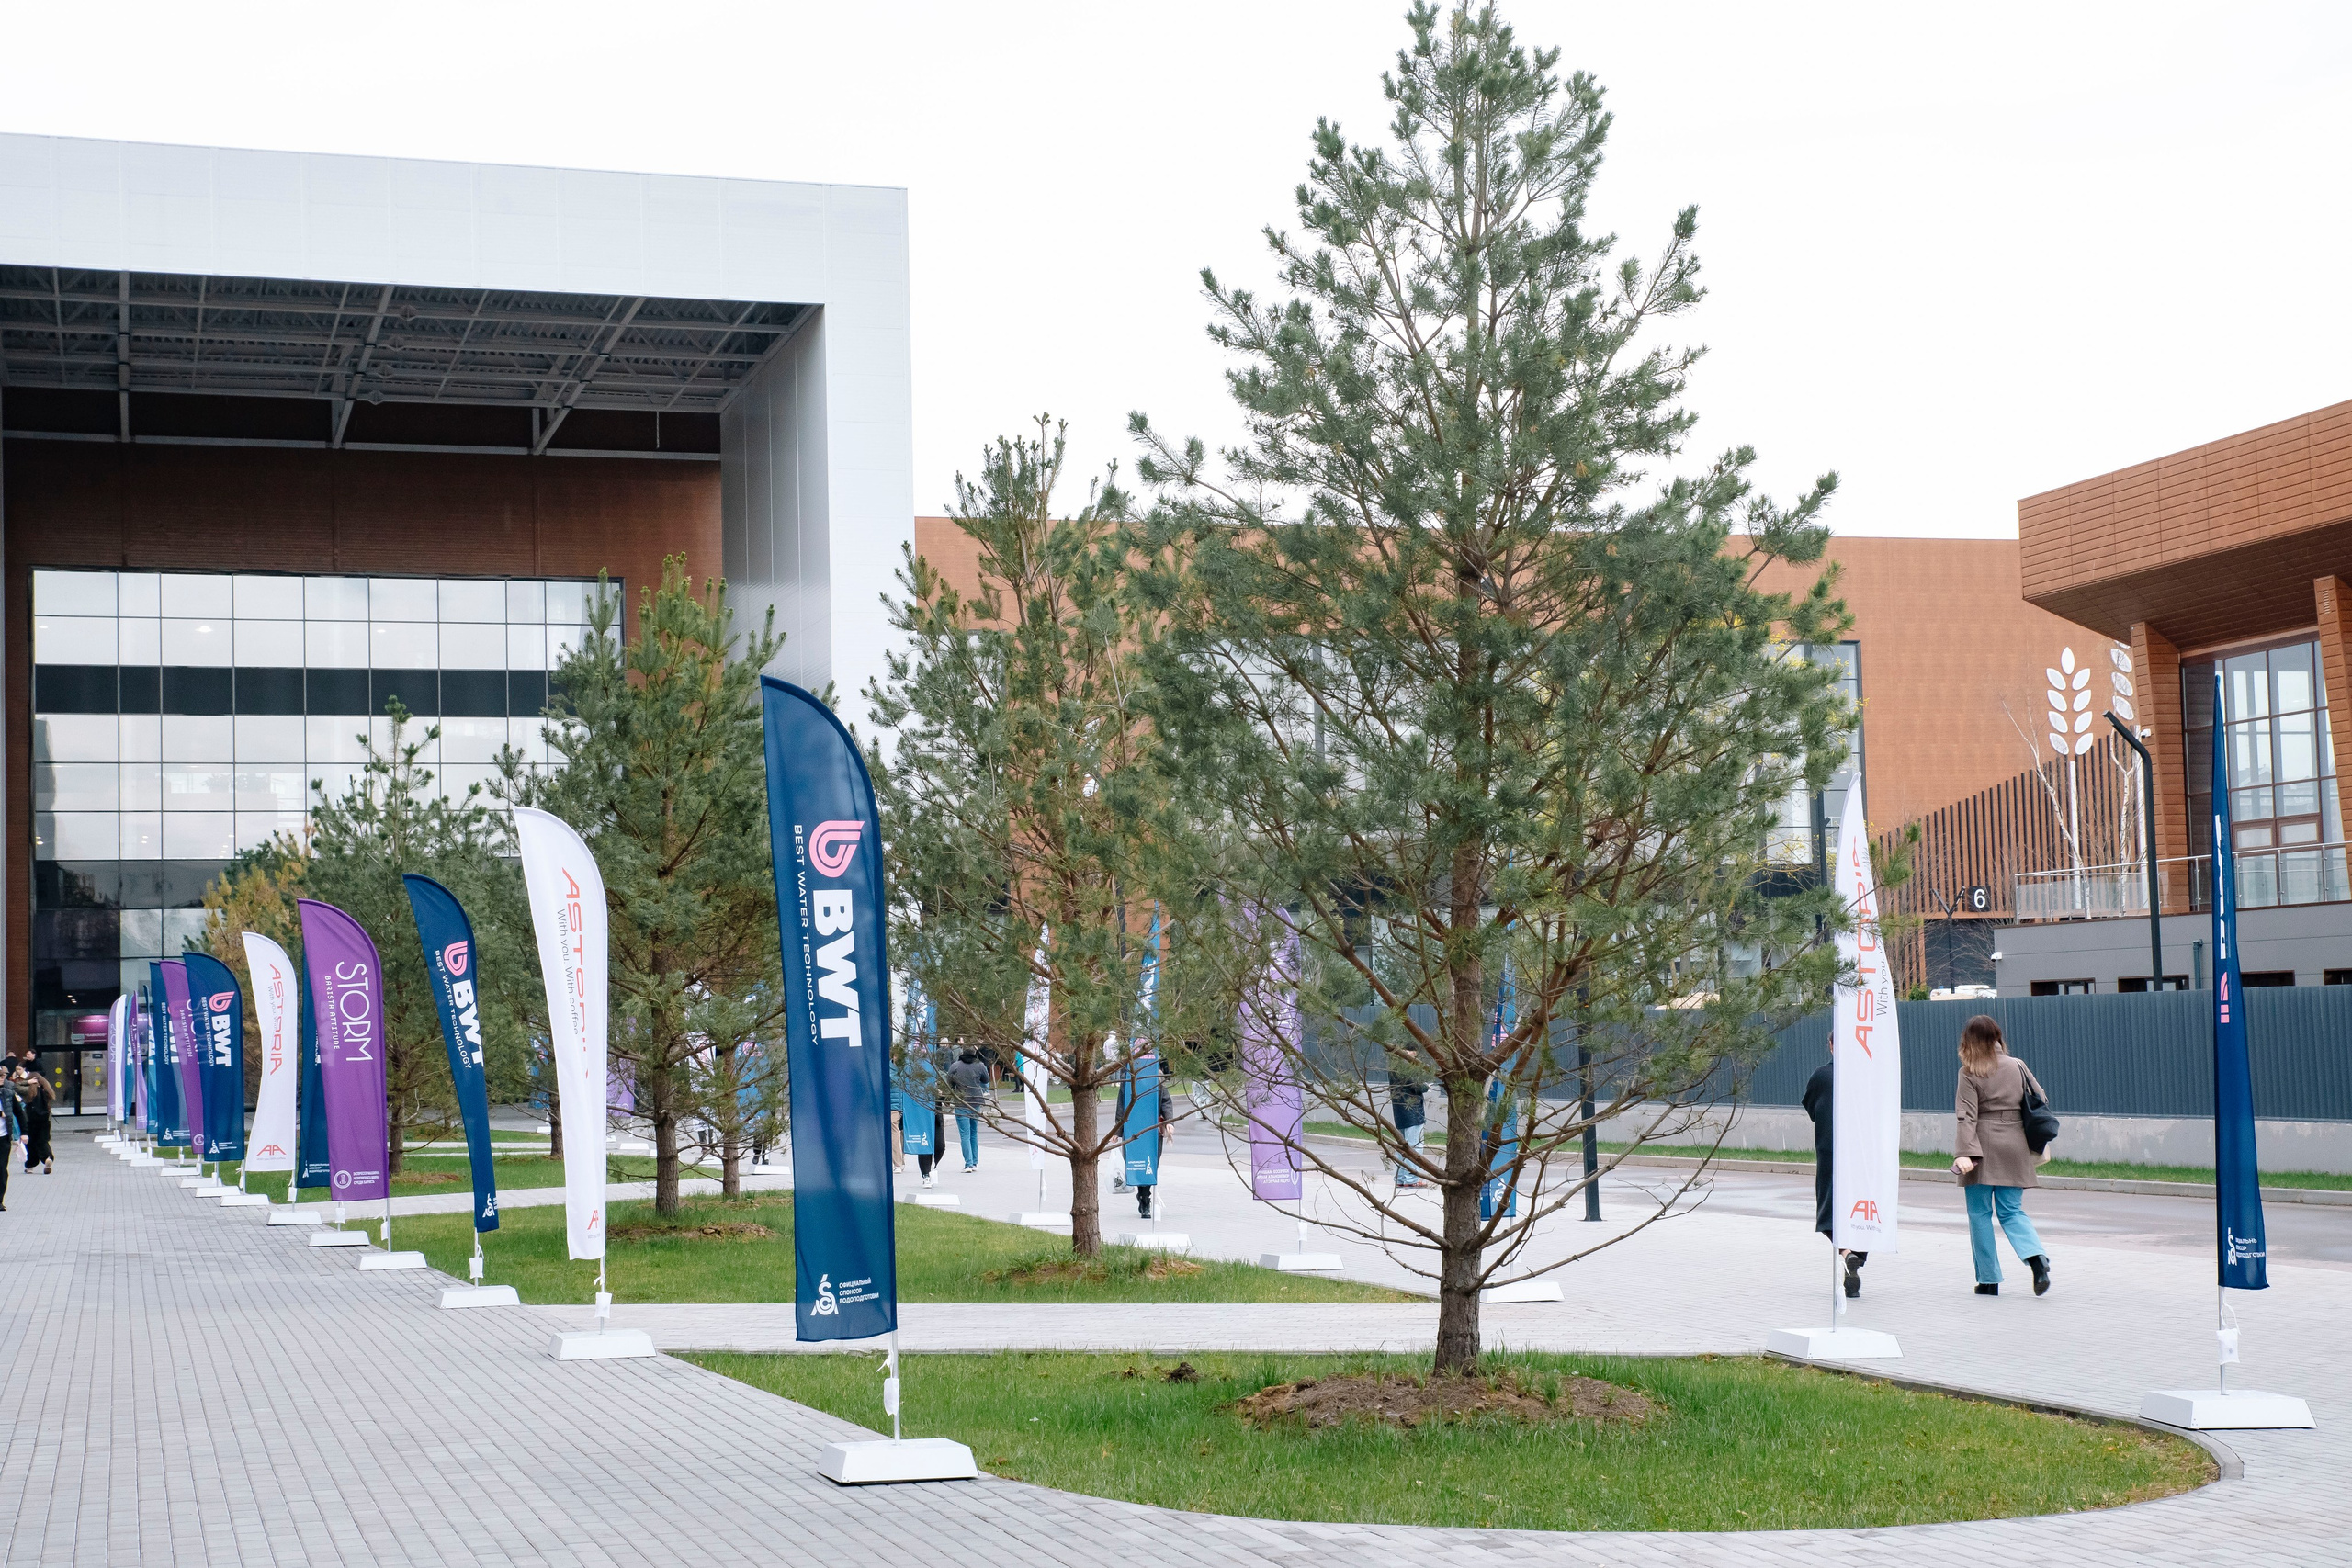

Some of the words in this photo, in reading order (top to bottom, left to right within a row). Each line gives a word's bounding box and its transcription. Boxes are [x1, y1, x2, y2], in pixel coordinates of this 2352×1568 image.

[794, 824, 805, 866] BEST
[797, 871, 808, 928] WATER
[1973, 888, 1986, 908] 6
[557, 908, 568, 937] With
[565, 965, 575, 994] With
[813, 889, 862, 1048] BWT
[324, 976, 334, 1010] BARISTA
[329, 1011, 340, 1050] ATTITUDE
[335, 961, 373, 1062] STORM
[435, 950, 446, 973] BEST
[442, 974, 454, 1006] WATER
[450, 1008, 472, 1069] TECHNOLOGY
[802, 932, 819, 1046] TECHNOLOGY
[1876, 987, 1888, 1016] With
[179, 1009, 187, 1032] BARISTA
[184, 1032, 193, 1058] ATTITUDE
[205, 1031, 215, 1066] TECHNOLOGY
[211, 1014, 232, 1066] BWT
[452, 979, 484, 1067] BWT
[839, 1277, 872, 1289] ОФИЦИАЛЬНЫЙ
[839, 1288, 862, 1296] СПОНСОР
[839, 1292, 879, 1304] ВОДОПОДГОТОВКИ
